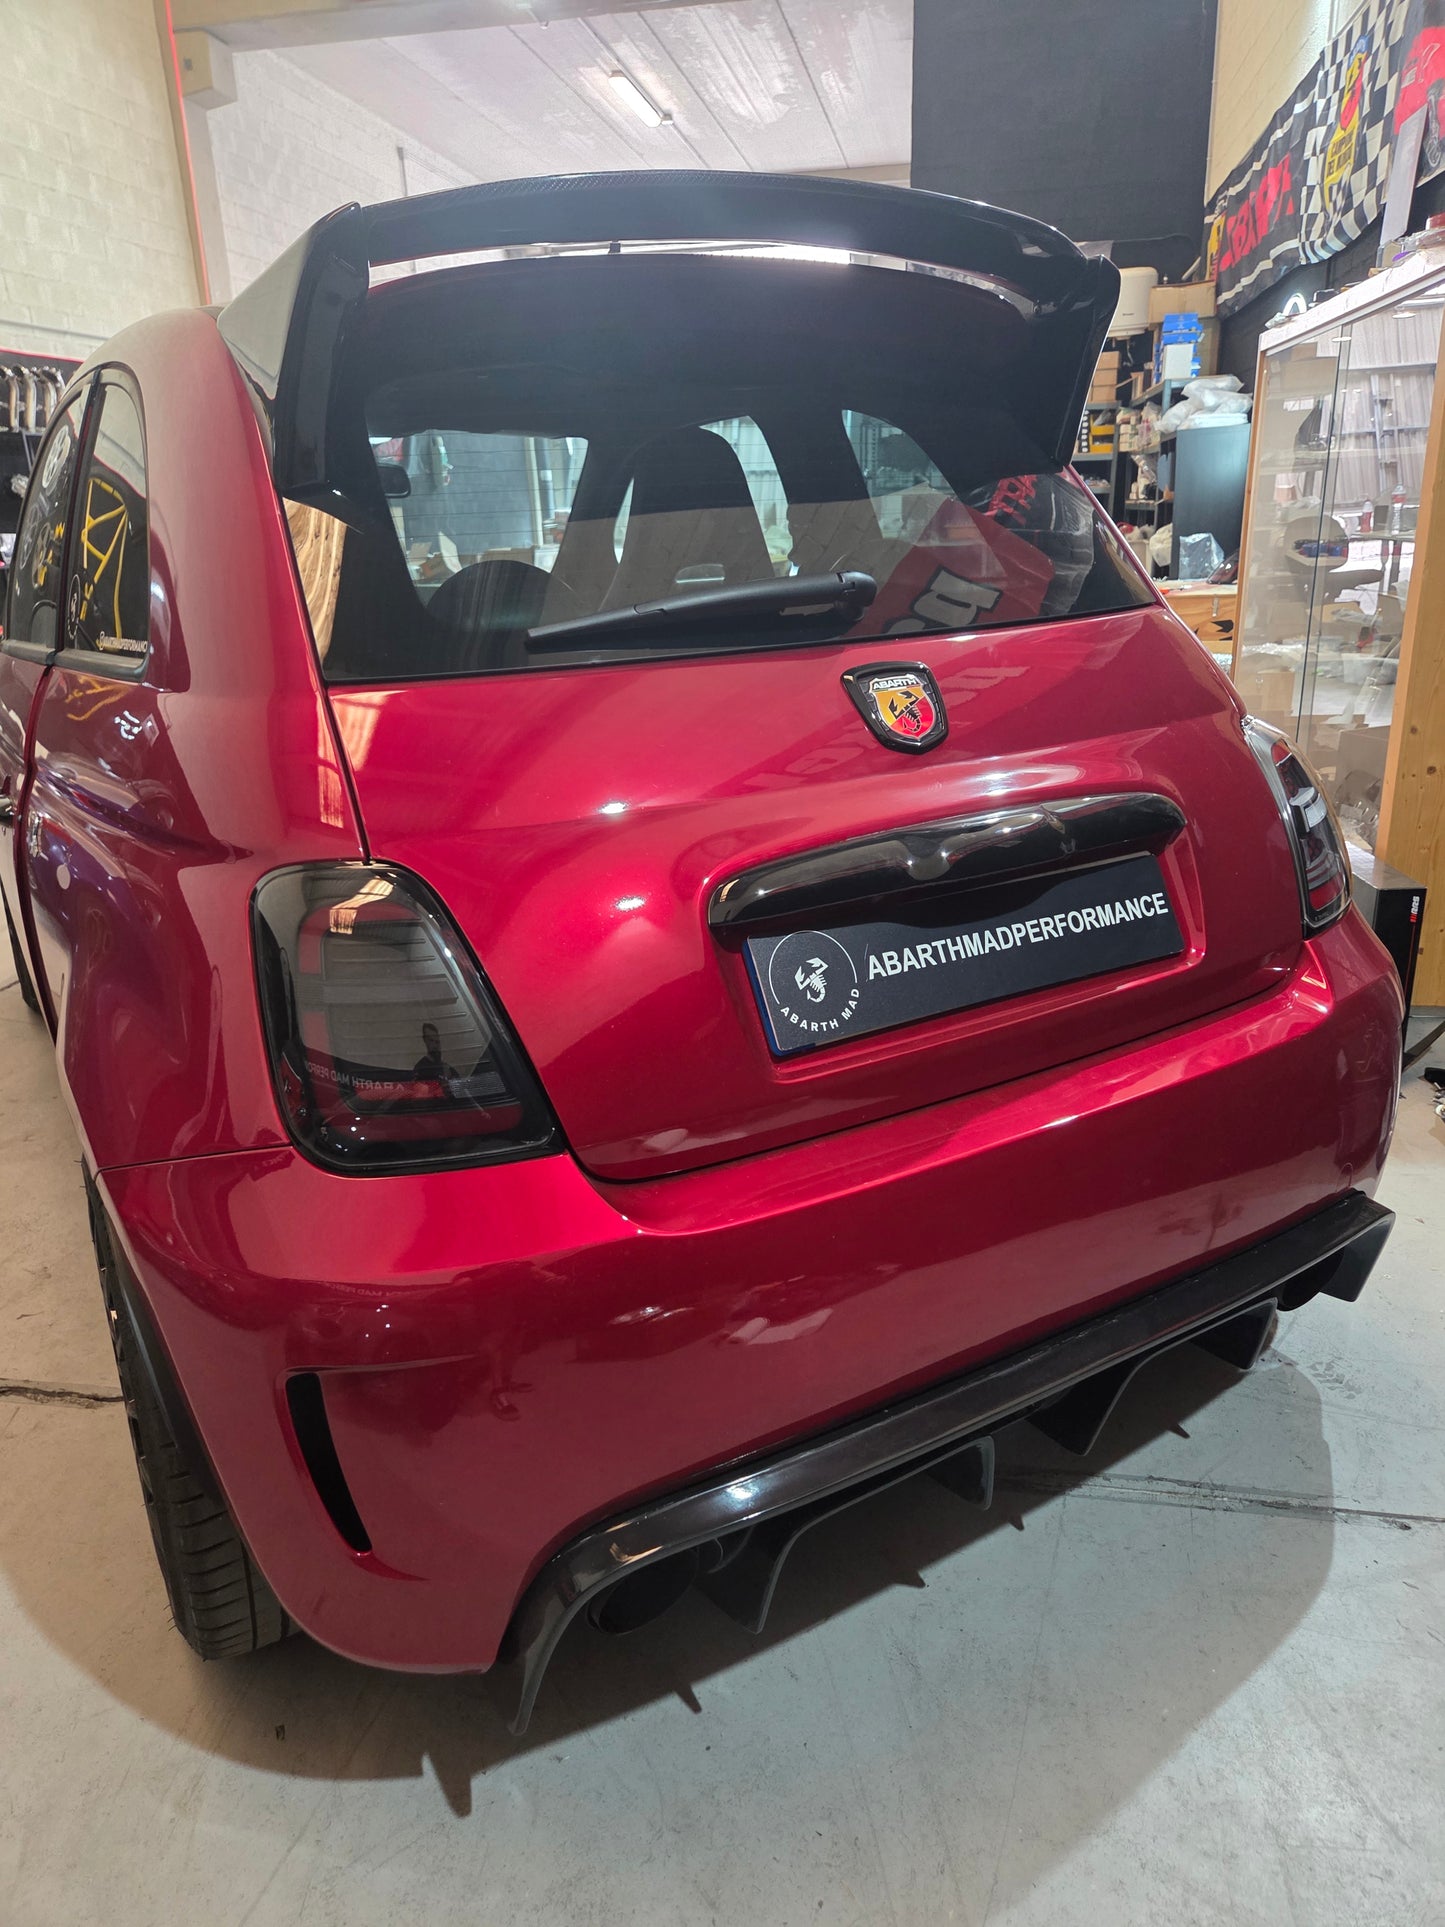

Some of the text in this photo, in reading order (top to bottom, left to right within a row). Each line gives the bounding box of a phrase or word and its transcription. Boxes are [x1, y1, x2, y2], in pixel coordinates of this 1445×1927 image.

[873, 678, 917, 690] ABARTH
[868, 892, 1169, 980] ABARTHMADPERFORMANCE
[780, 988, 860, 1032] ABARTH MAD
